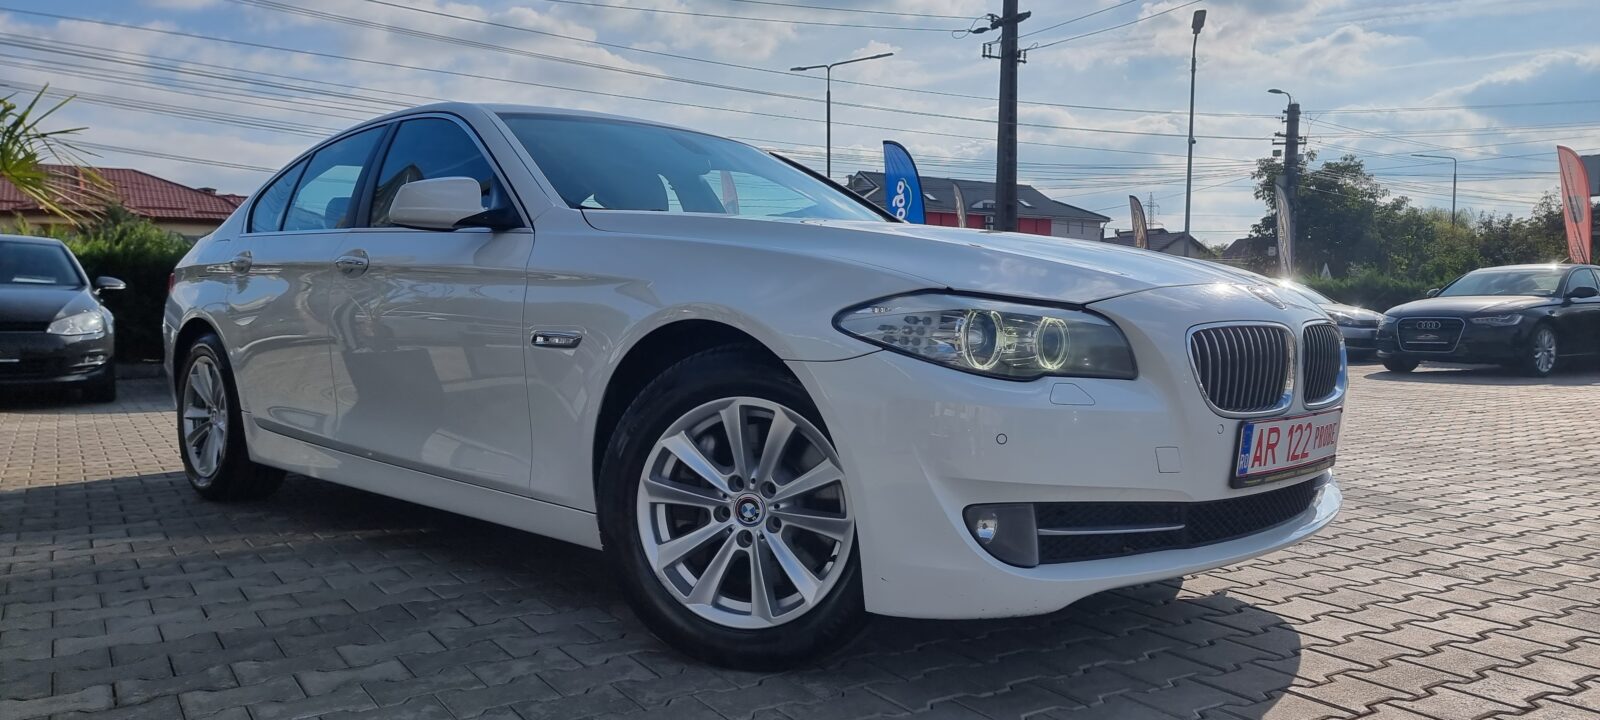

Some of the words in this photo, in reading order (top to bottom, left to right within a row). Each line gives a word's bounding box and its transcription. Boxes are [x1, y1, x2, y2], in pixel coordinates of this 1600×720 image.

[1251, 427, 1280, 468] AR
[1287, 422, 1312, 462] 122
[1238, 454, 1250, 469] RO
